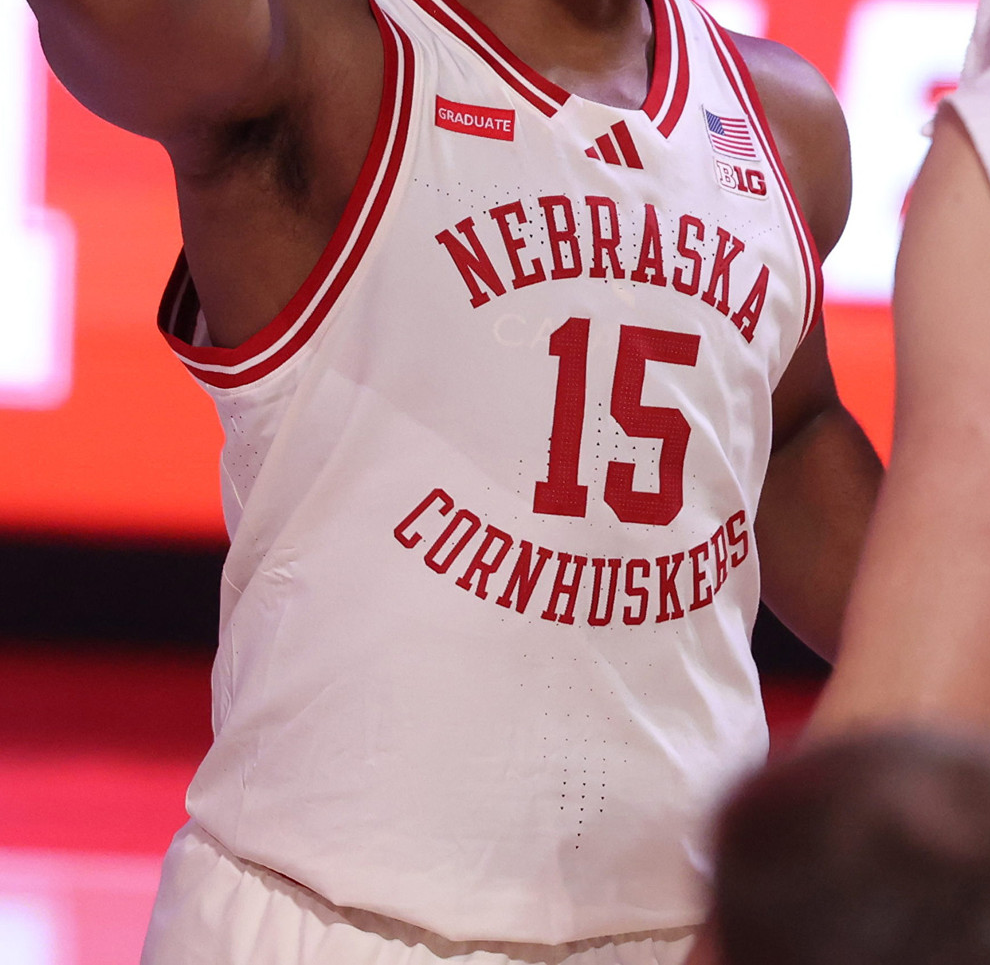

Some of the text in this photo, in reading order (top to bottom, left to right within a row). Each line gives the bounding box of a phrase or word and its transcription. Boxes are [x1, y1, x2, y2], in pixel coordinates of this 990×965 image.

[438, 107, 511, 132] GRADUATE
[435, 195, 770, 344] NEBRASKA
[533, 317, 700, 526] 15
[394, 488, 749, 626] CORNHUSKERS
